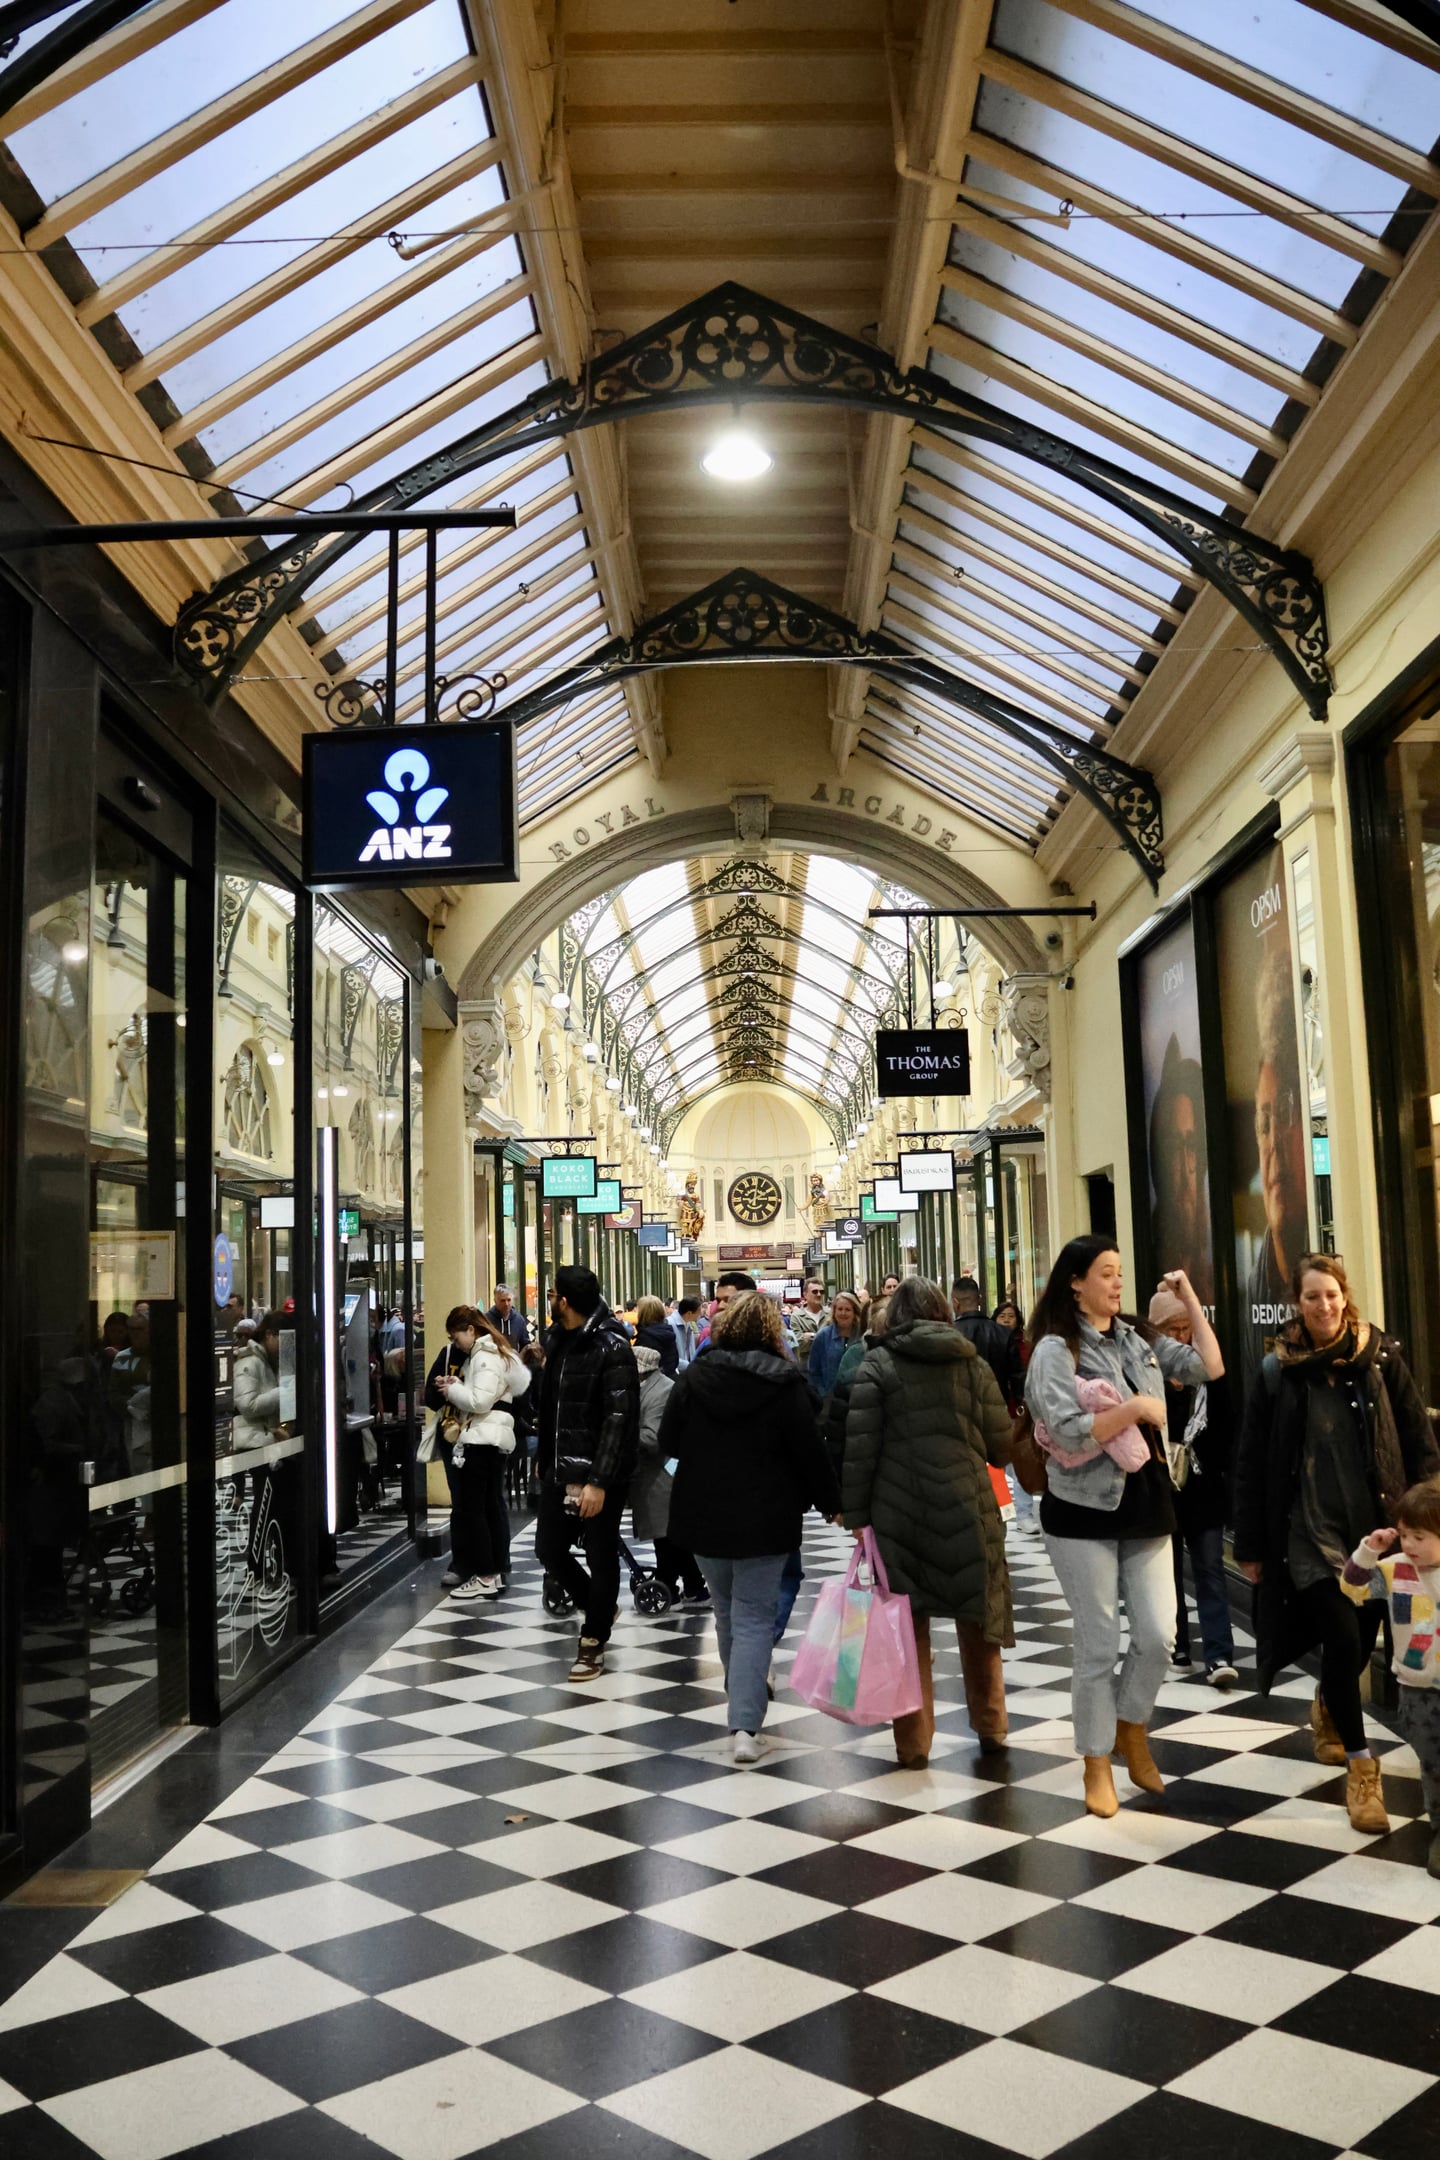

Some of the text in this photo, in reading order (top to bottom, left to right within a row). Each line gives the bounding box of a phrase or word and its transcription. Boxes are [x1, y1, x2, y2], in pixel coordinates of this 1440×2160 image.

[547, 783, 958, 862] ROYAL ARCADE
[358, 824, 452, 862] ANZ
[1250, 882, 1281, 928] OPSM
[1162, 960, 1185, 995] OPSM
[886, 1055, 961, 1070] THOMAS
[549, 1175, 588, 1183] BLACK
[552, 1164, 585, 1173] KOKO
